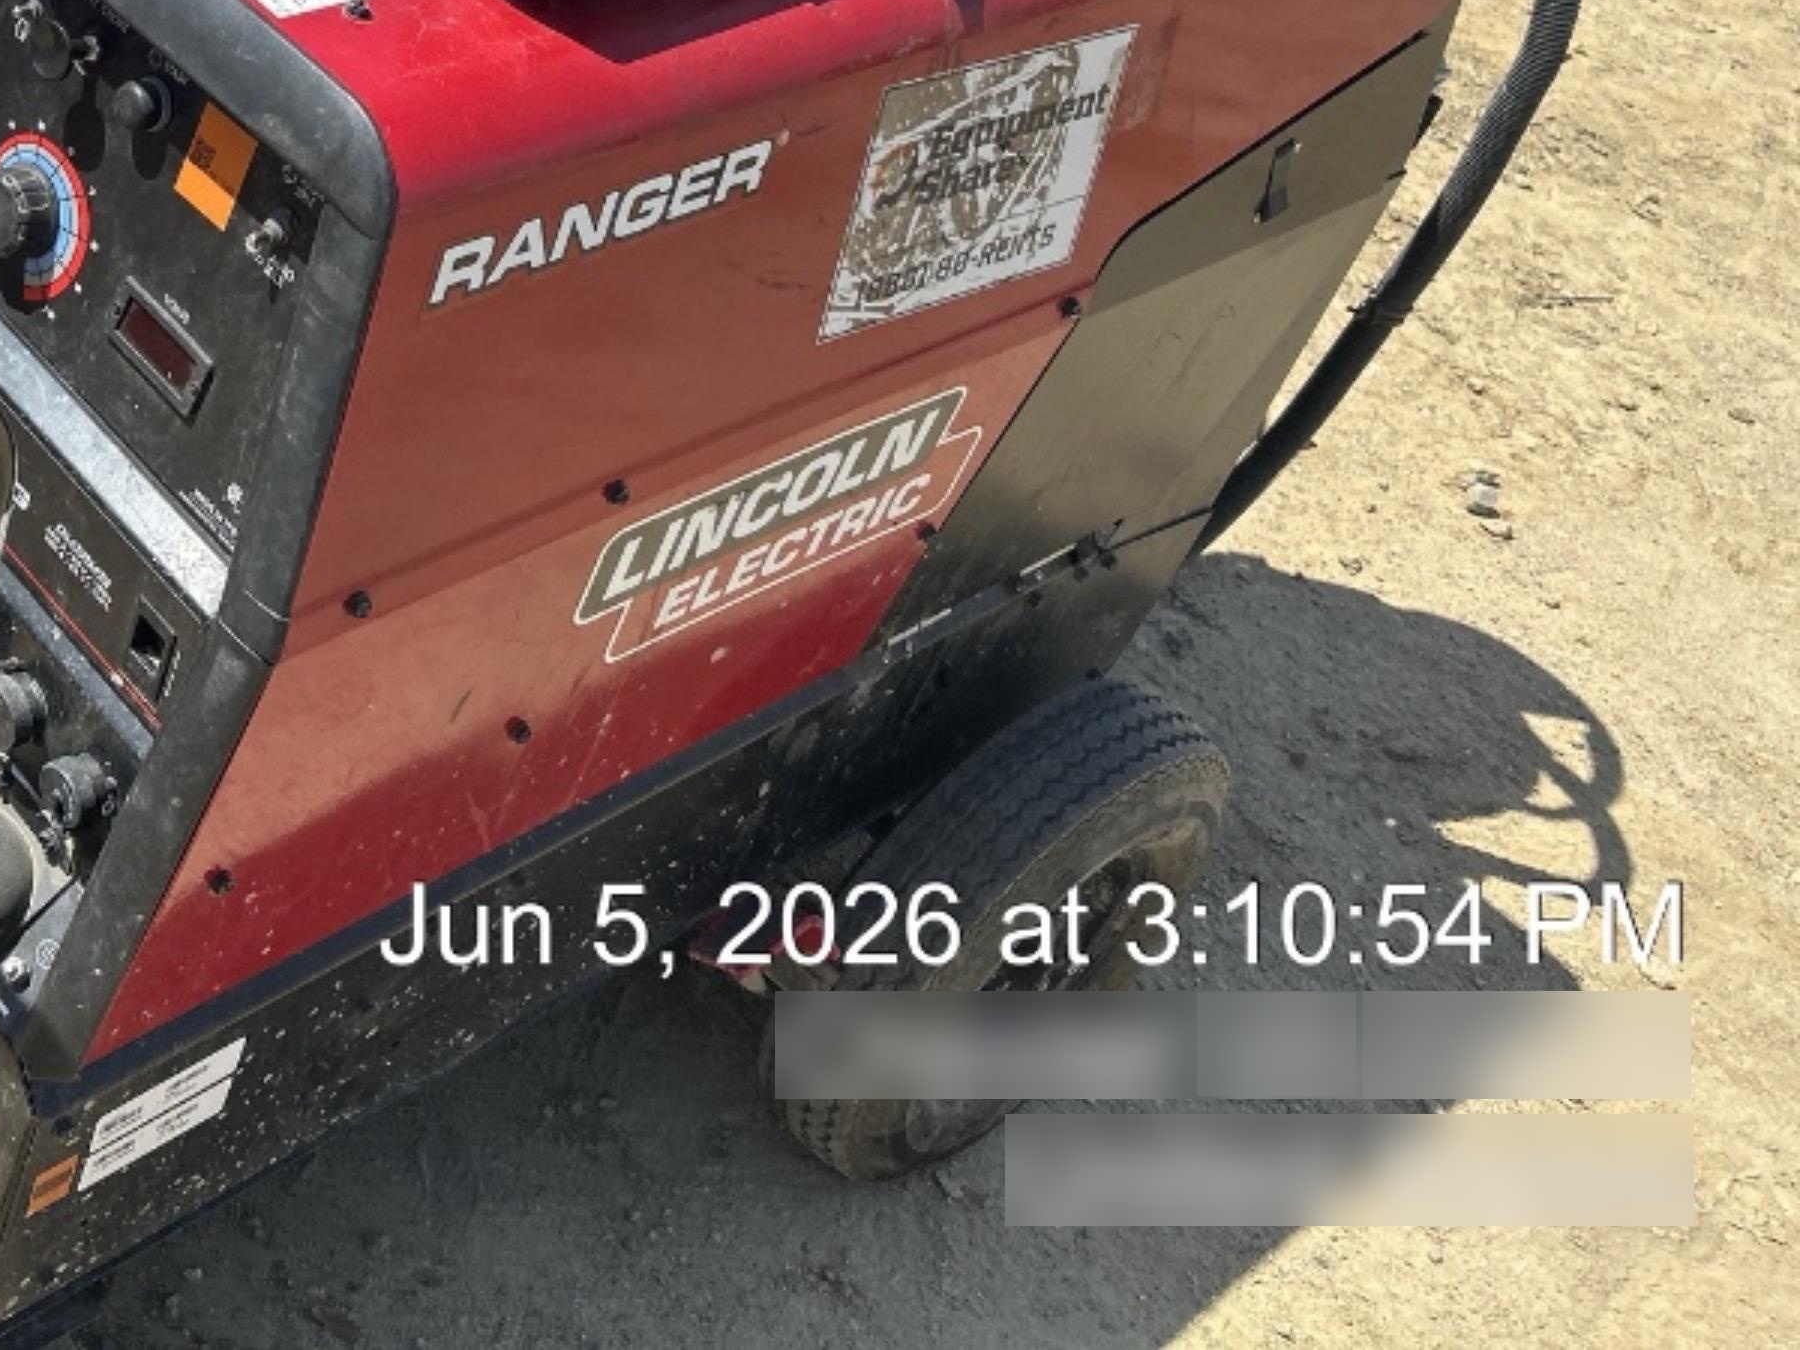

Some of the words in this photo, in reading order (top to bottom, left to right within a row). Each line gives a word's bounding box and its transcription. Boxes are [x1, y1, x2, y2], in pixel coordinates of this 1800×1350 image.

[429, 139, 774, 305] RANGER
[602, 409, 940, 602] LINCOLN
[654, 473, 932, 629] ELECTRIC
